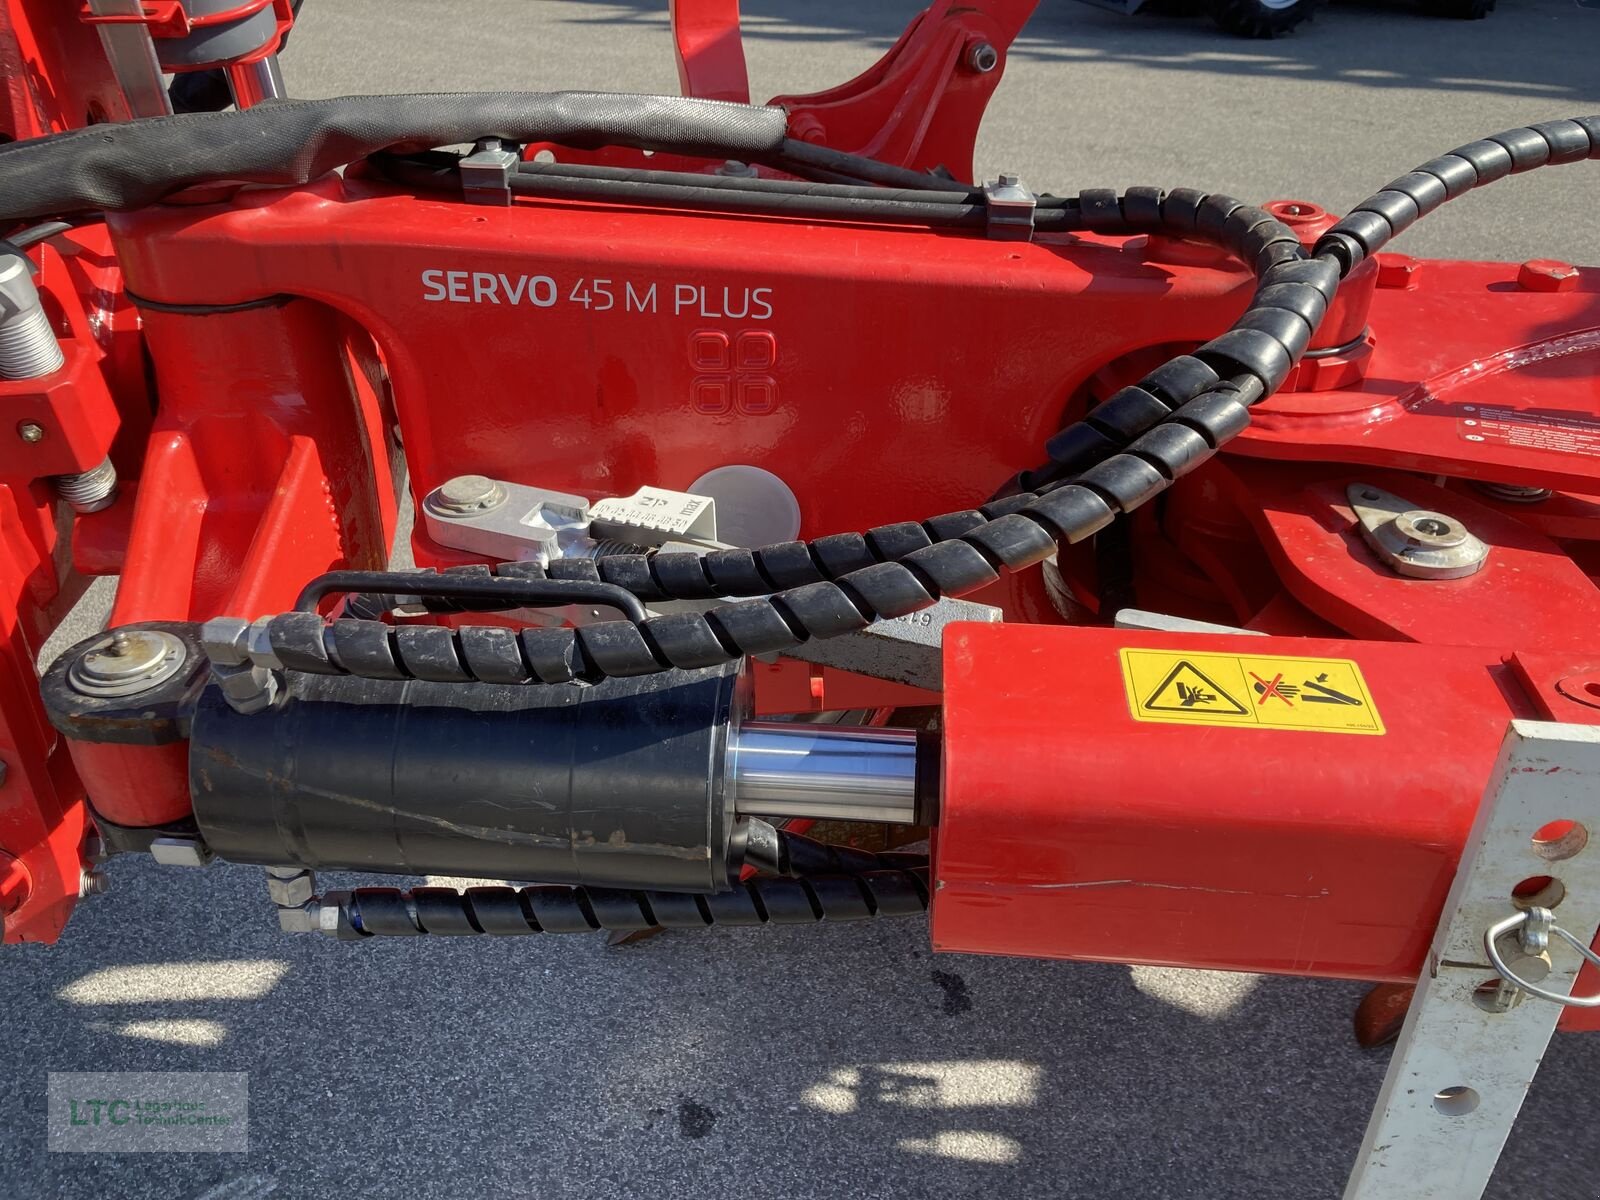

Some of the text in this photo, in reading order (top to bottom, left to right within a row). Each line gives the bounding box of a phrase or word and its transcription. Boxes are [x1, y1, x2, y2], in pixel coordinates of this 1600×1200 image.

[422, 269, 773, 320] SERVO 45 M PLUS
[680, 499, 703, 517] max
